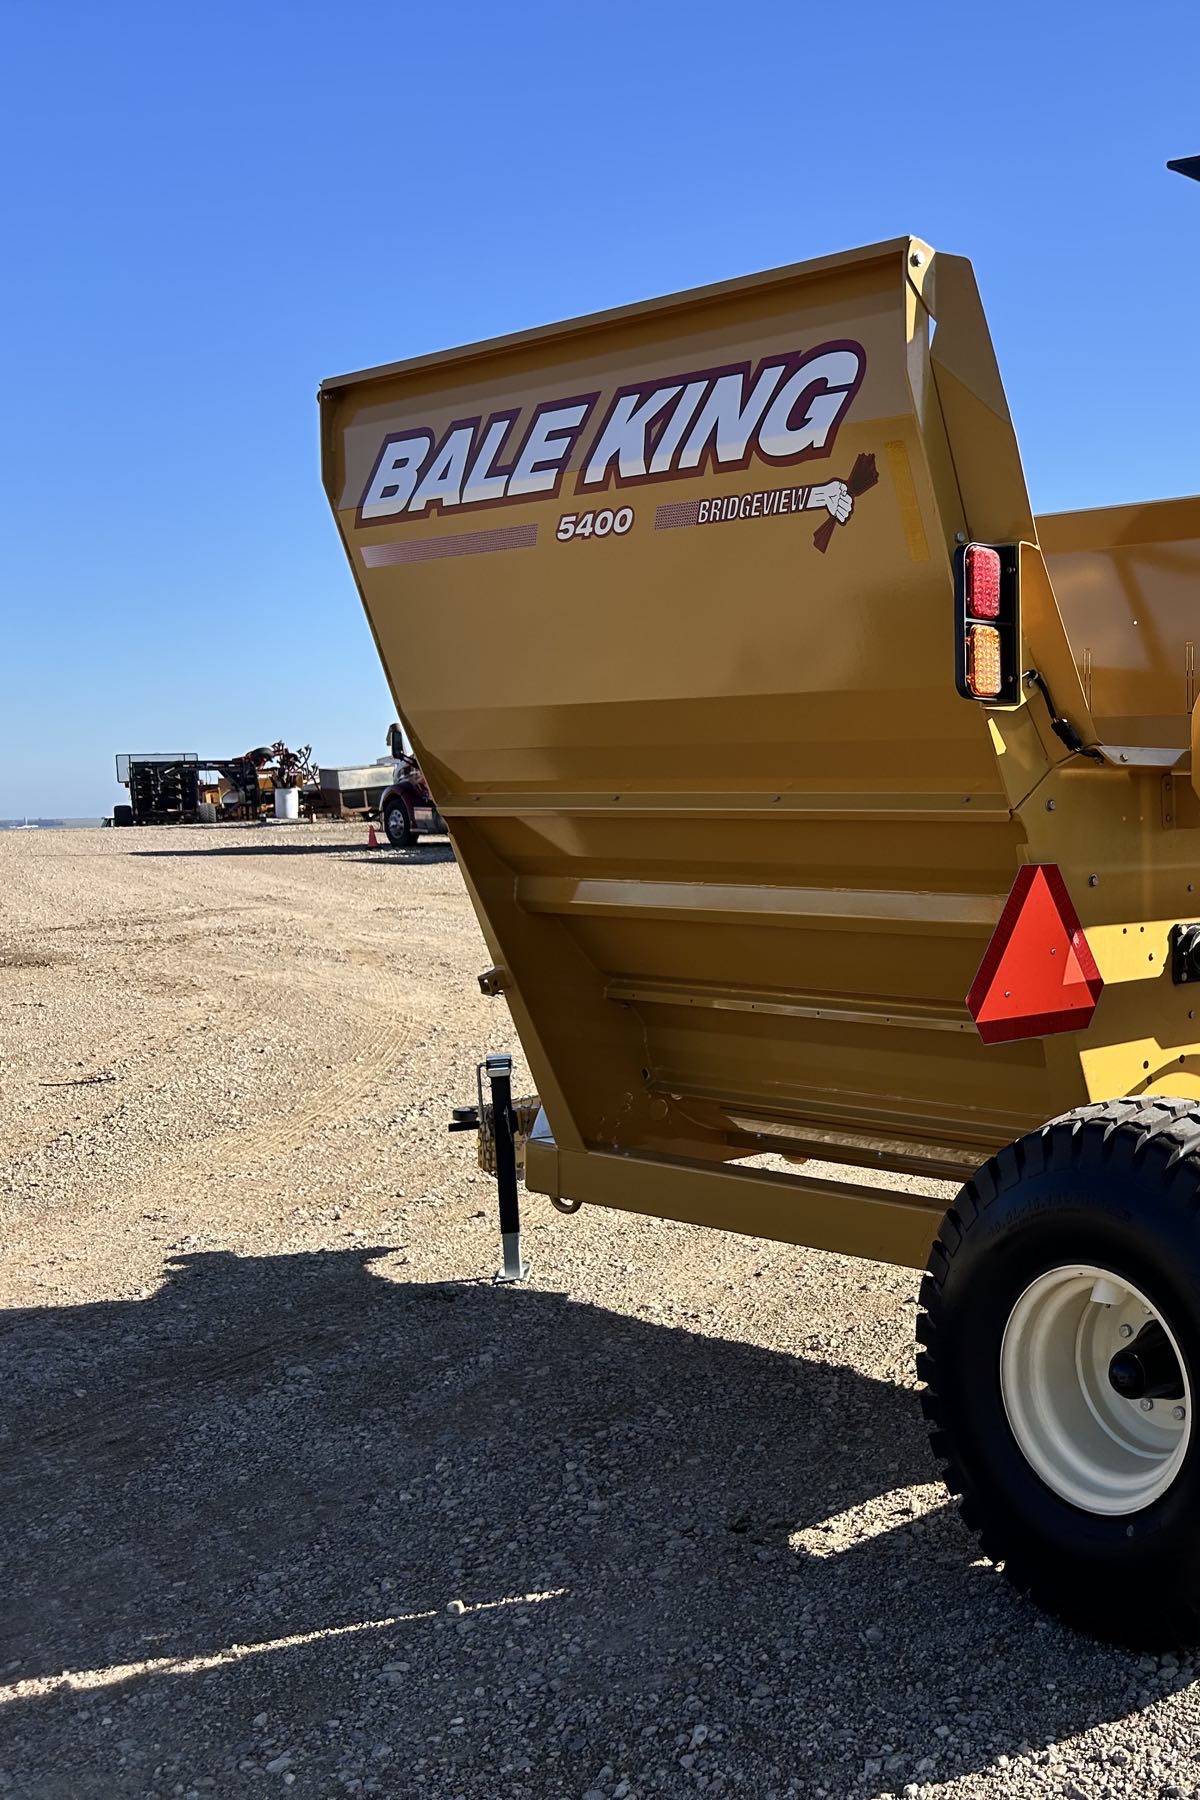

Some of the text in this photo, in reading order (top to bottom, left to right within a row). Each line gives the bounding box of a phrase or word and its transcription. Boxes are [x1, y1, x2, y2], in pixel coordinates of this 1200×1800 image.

[359, 347, 862, 521] BALE KING
[697, 488, 807, 524] BRIDGEVIEW
[556, 507, 634, 542] 5400
